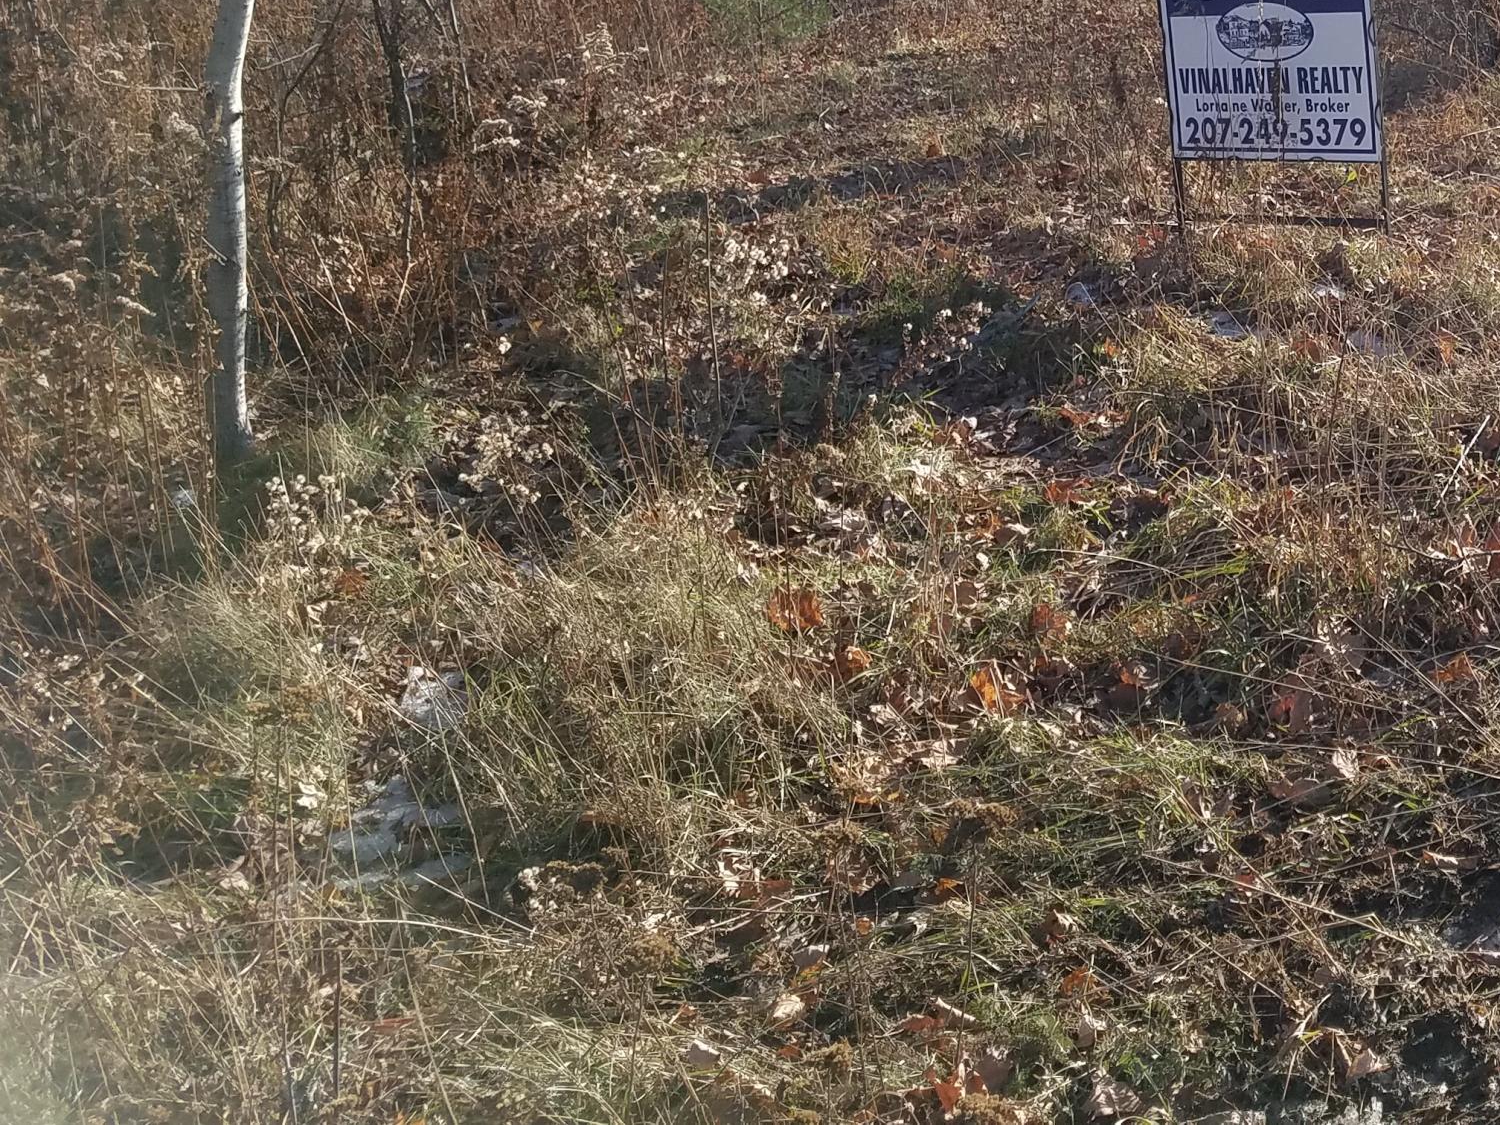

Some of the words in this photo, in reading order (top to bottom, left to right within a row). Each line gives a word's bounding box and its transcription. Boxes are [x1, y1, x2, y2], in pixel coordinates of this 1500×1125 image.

[1297, 66, 1363, 94] REALTY
[1196, 98, 1247, 112] Lorrane
[1251, 98, 1300, 115] Waer,
[1305, 97, 1350, 112] Broker
